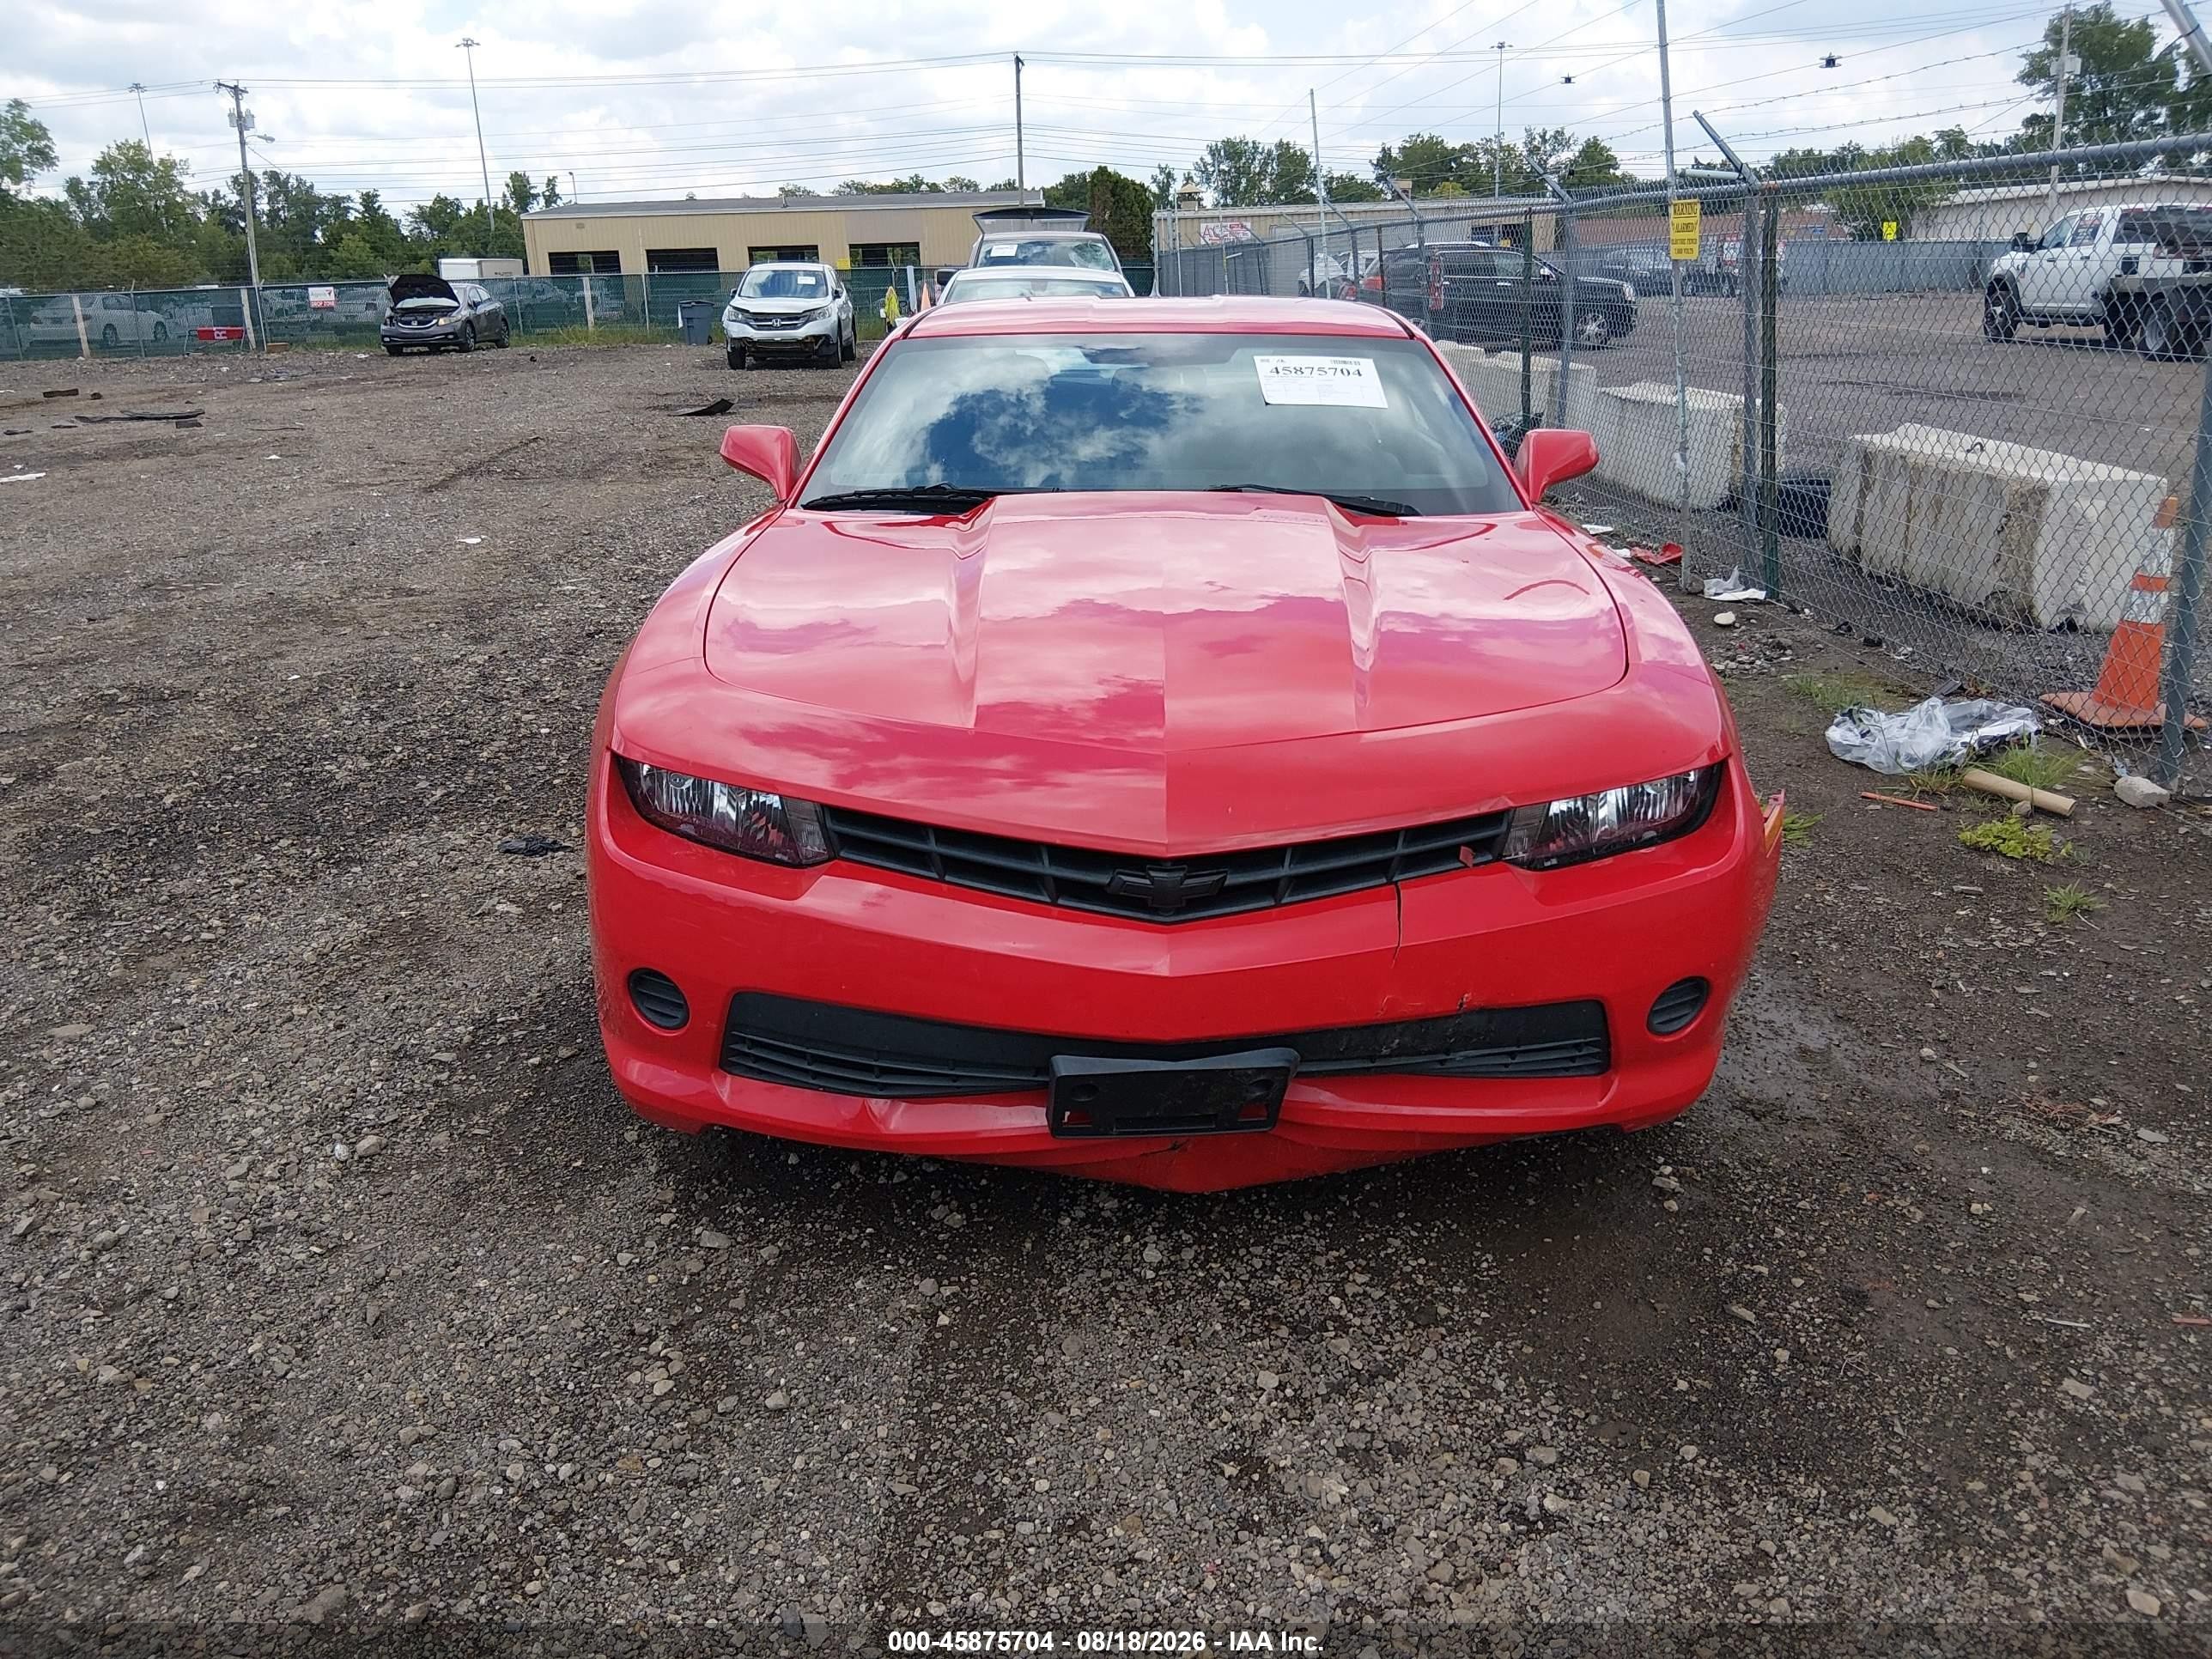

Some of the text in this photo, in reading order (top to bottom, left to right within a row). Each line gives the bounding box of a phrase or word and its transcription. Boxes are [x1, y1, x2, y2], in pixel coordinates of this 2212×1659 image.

[1673, 202, 1698, 216] WARNING
[1674, 222, 1694, 233] ALARMED
[1269, 365, 1363, 377] 45875704
